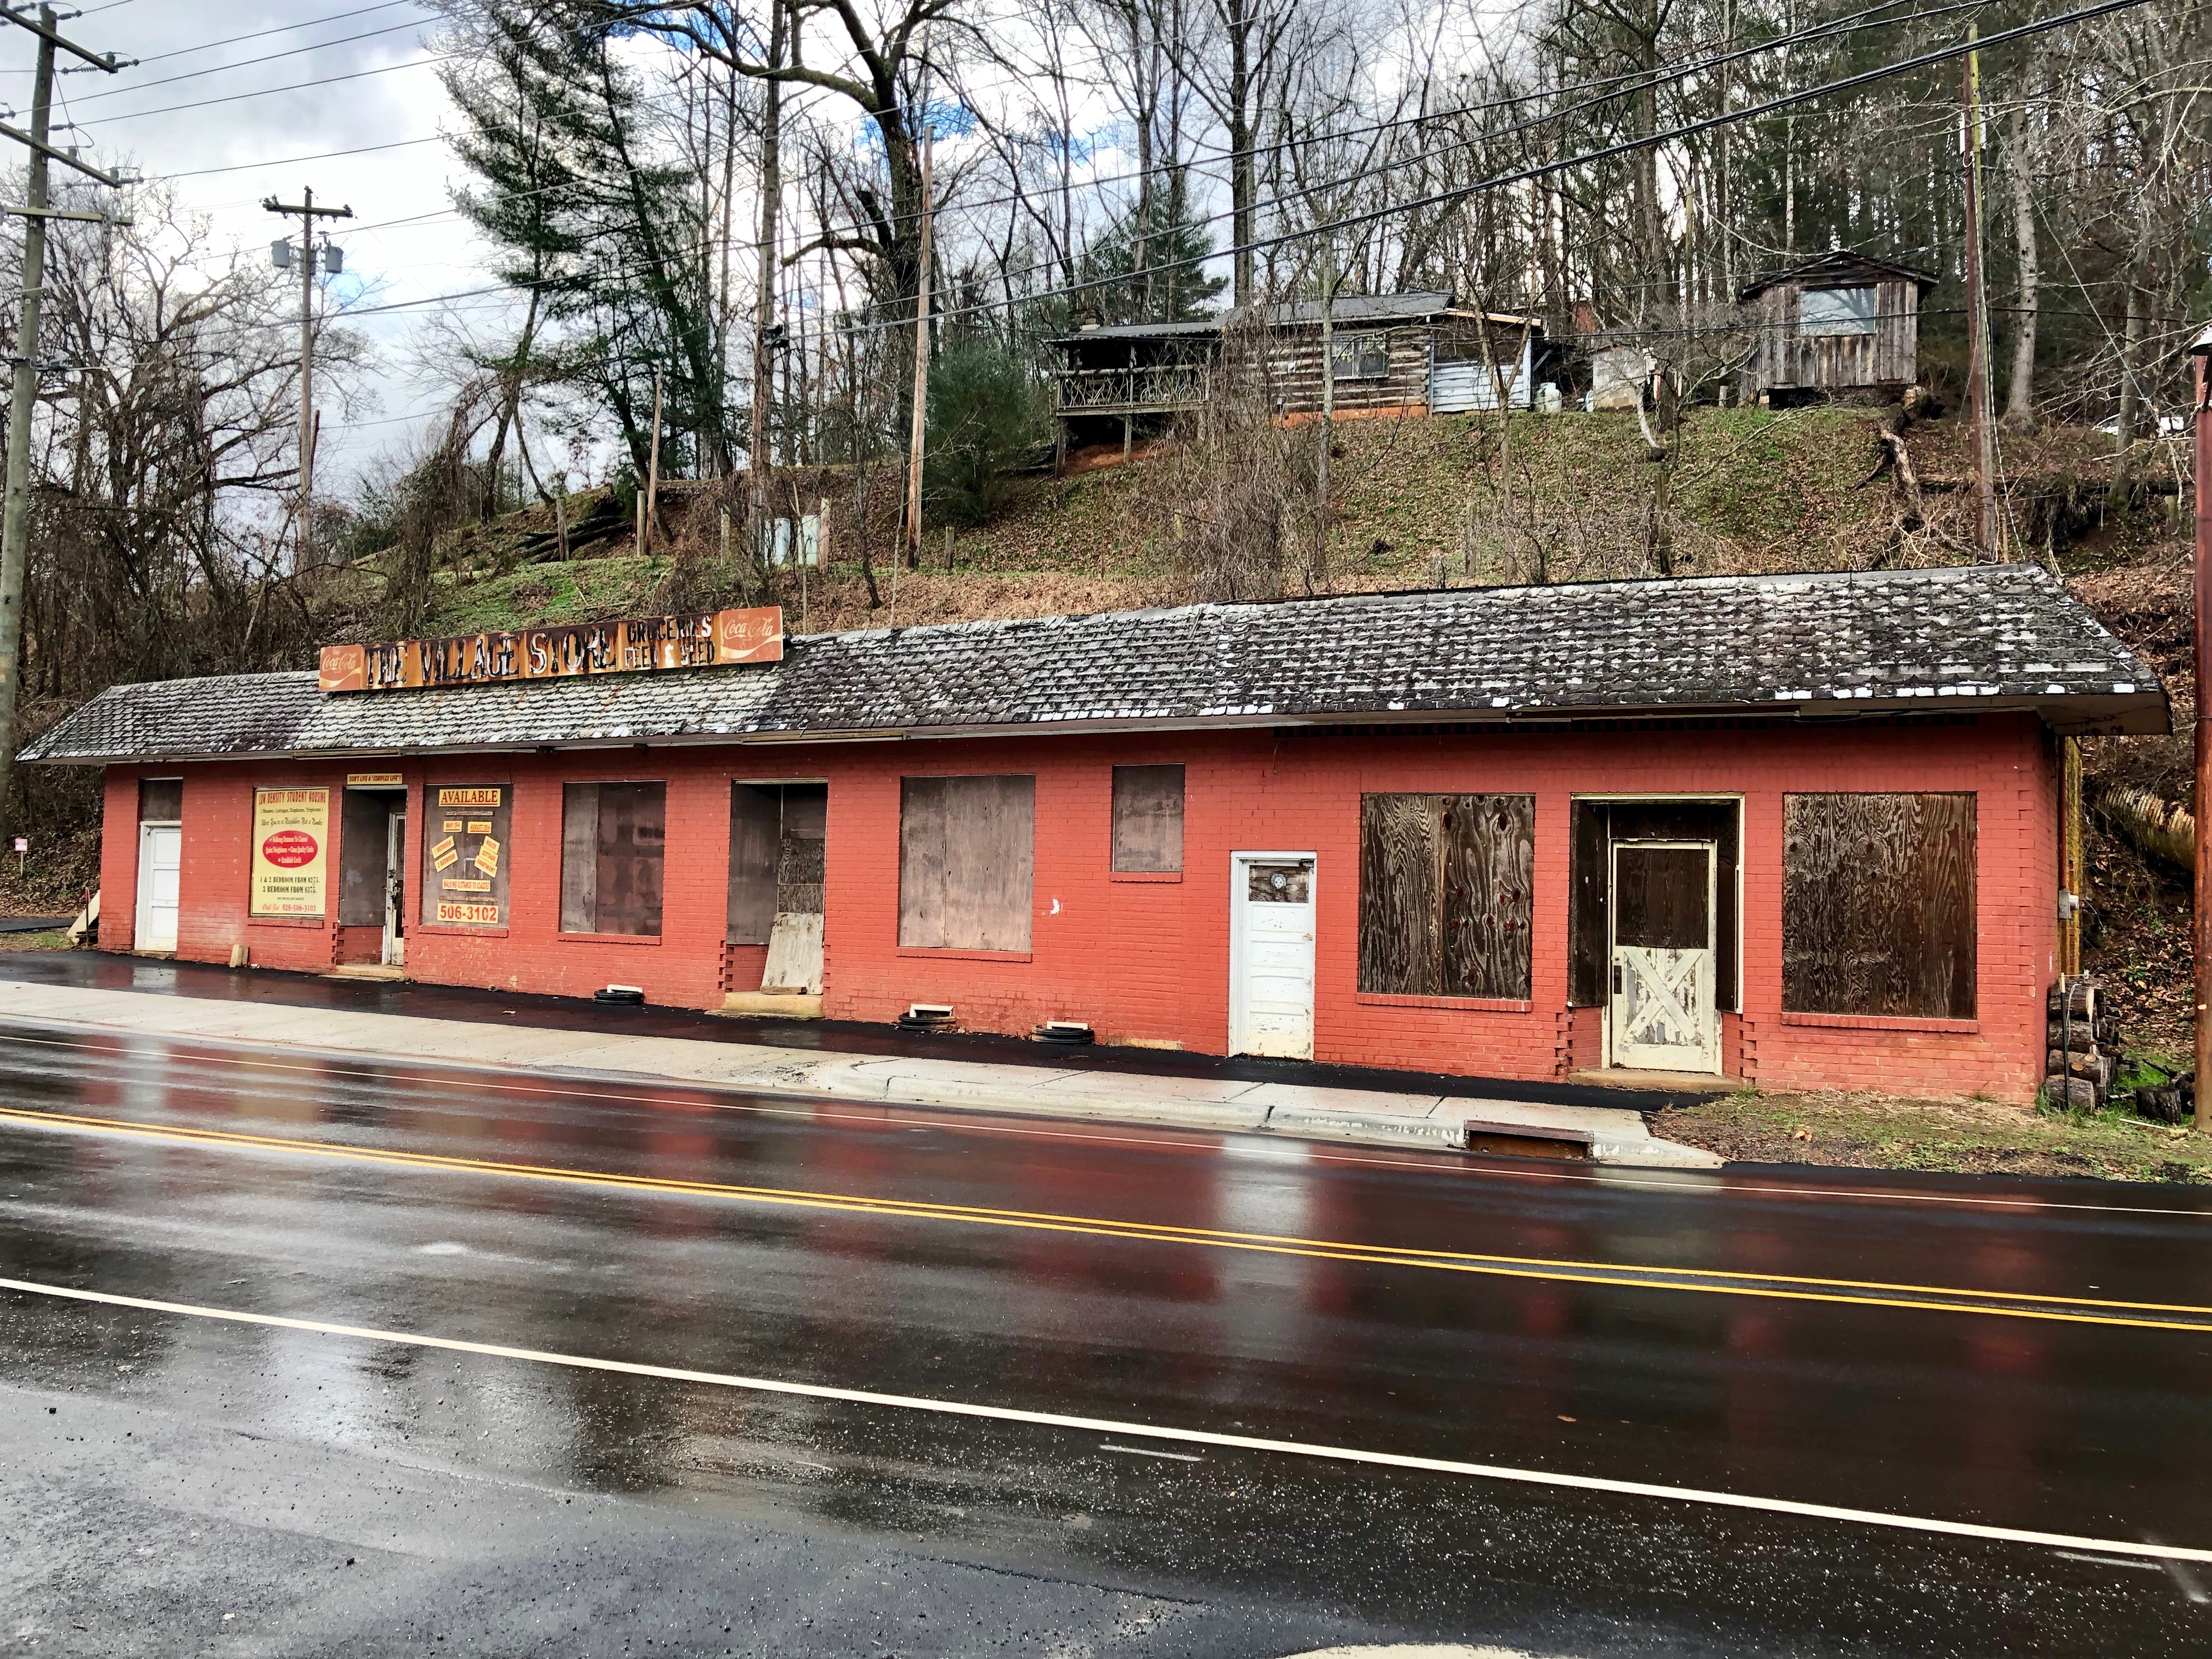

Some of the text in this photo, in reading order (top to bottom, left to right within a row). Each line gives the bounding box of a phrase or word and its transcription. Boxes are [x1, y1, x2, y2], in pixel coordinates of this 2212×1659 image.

[365, 625, 617, 686] THE VILLAGE STORE
[624, 646, 658, 670] FEED
[681, 641, 715, 665] SEED
[268, 792, 285, 804] DENSITY
[287, 791, 307, 803] STUDENT
[309, 791, 326, 803] HOUSING
[441, 791, 498, 803] AVAILABLE
[477, 859, 495, 873] APARTMENT
[282, 904, 316, 912] 828-506-3102
[441, 905, 496, 921] 506-3102
